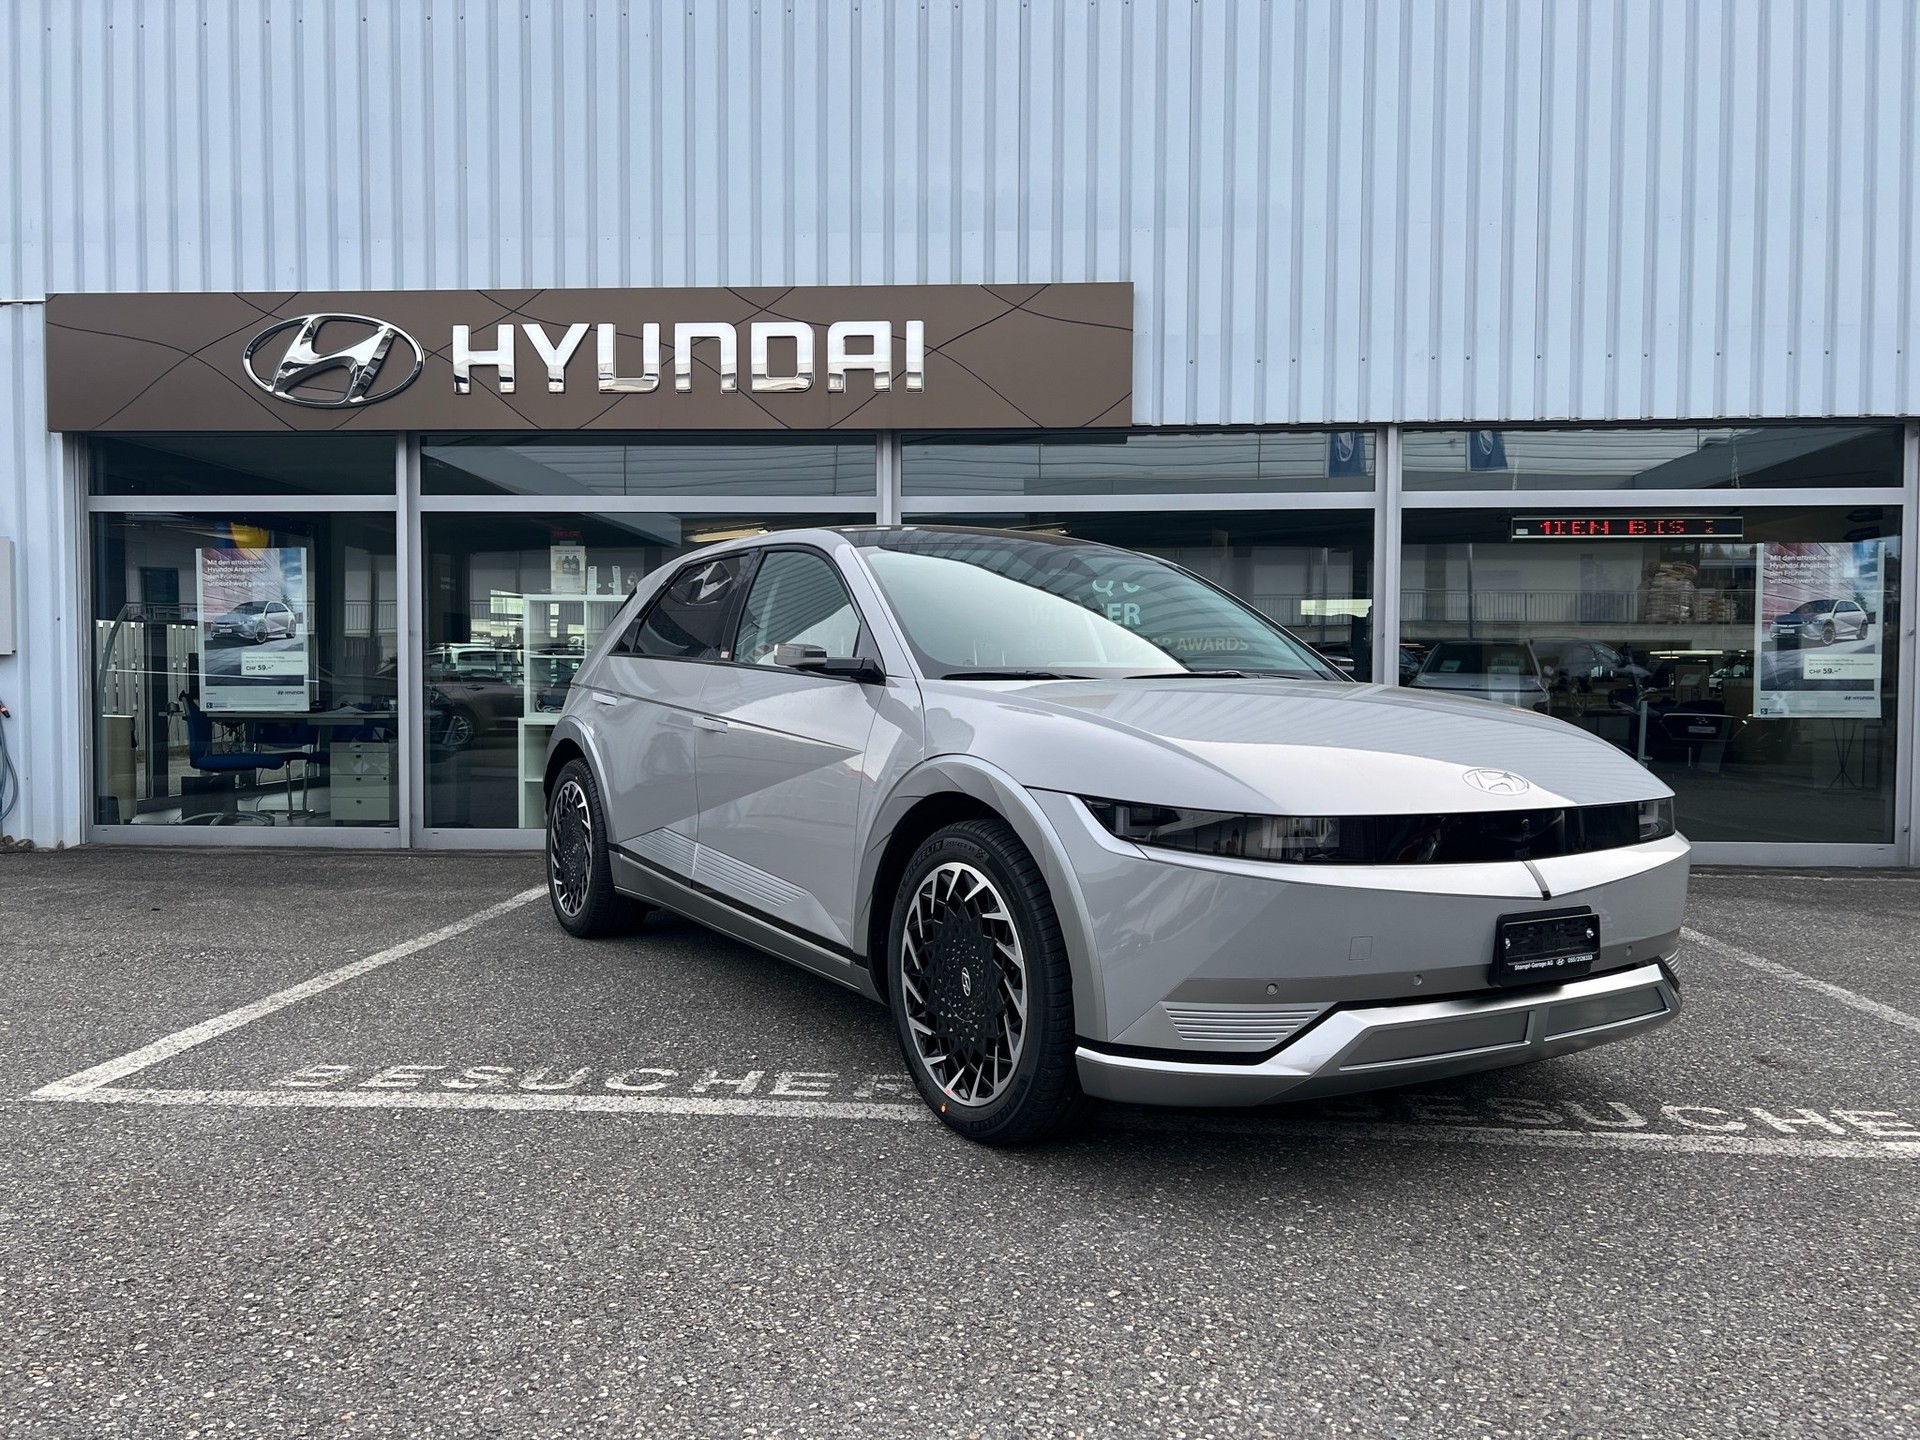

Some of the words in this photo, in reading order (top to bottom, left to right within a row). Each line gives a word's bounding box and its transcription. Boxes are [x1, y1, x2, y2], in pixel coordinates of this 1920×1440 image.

[452, 320, 925, 395] HYUNDAI
[1628, 520, 1685, 534] BIS
[1177, 637, 1249, 651] AWARDS
